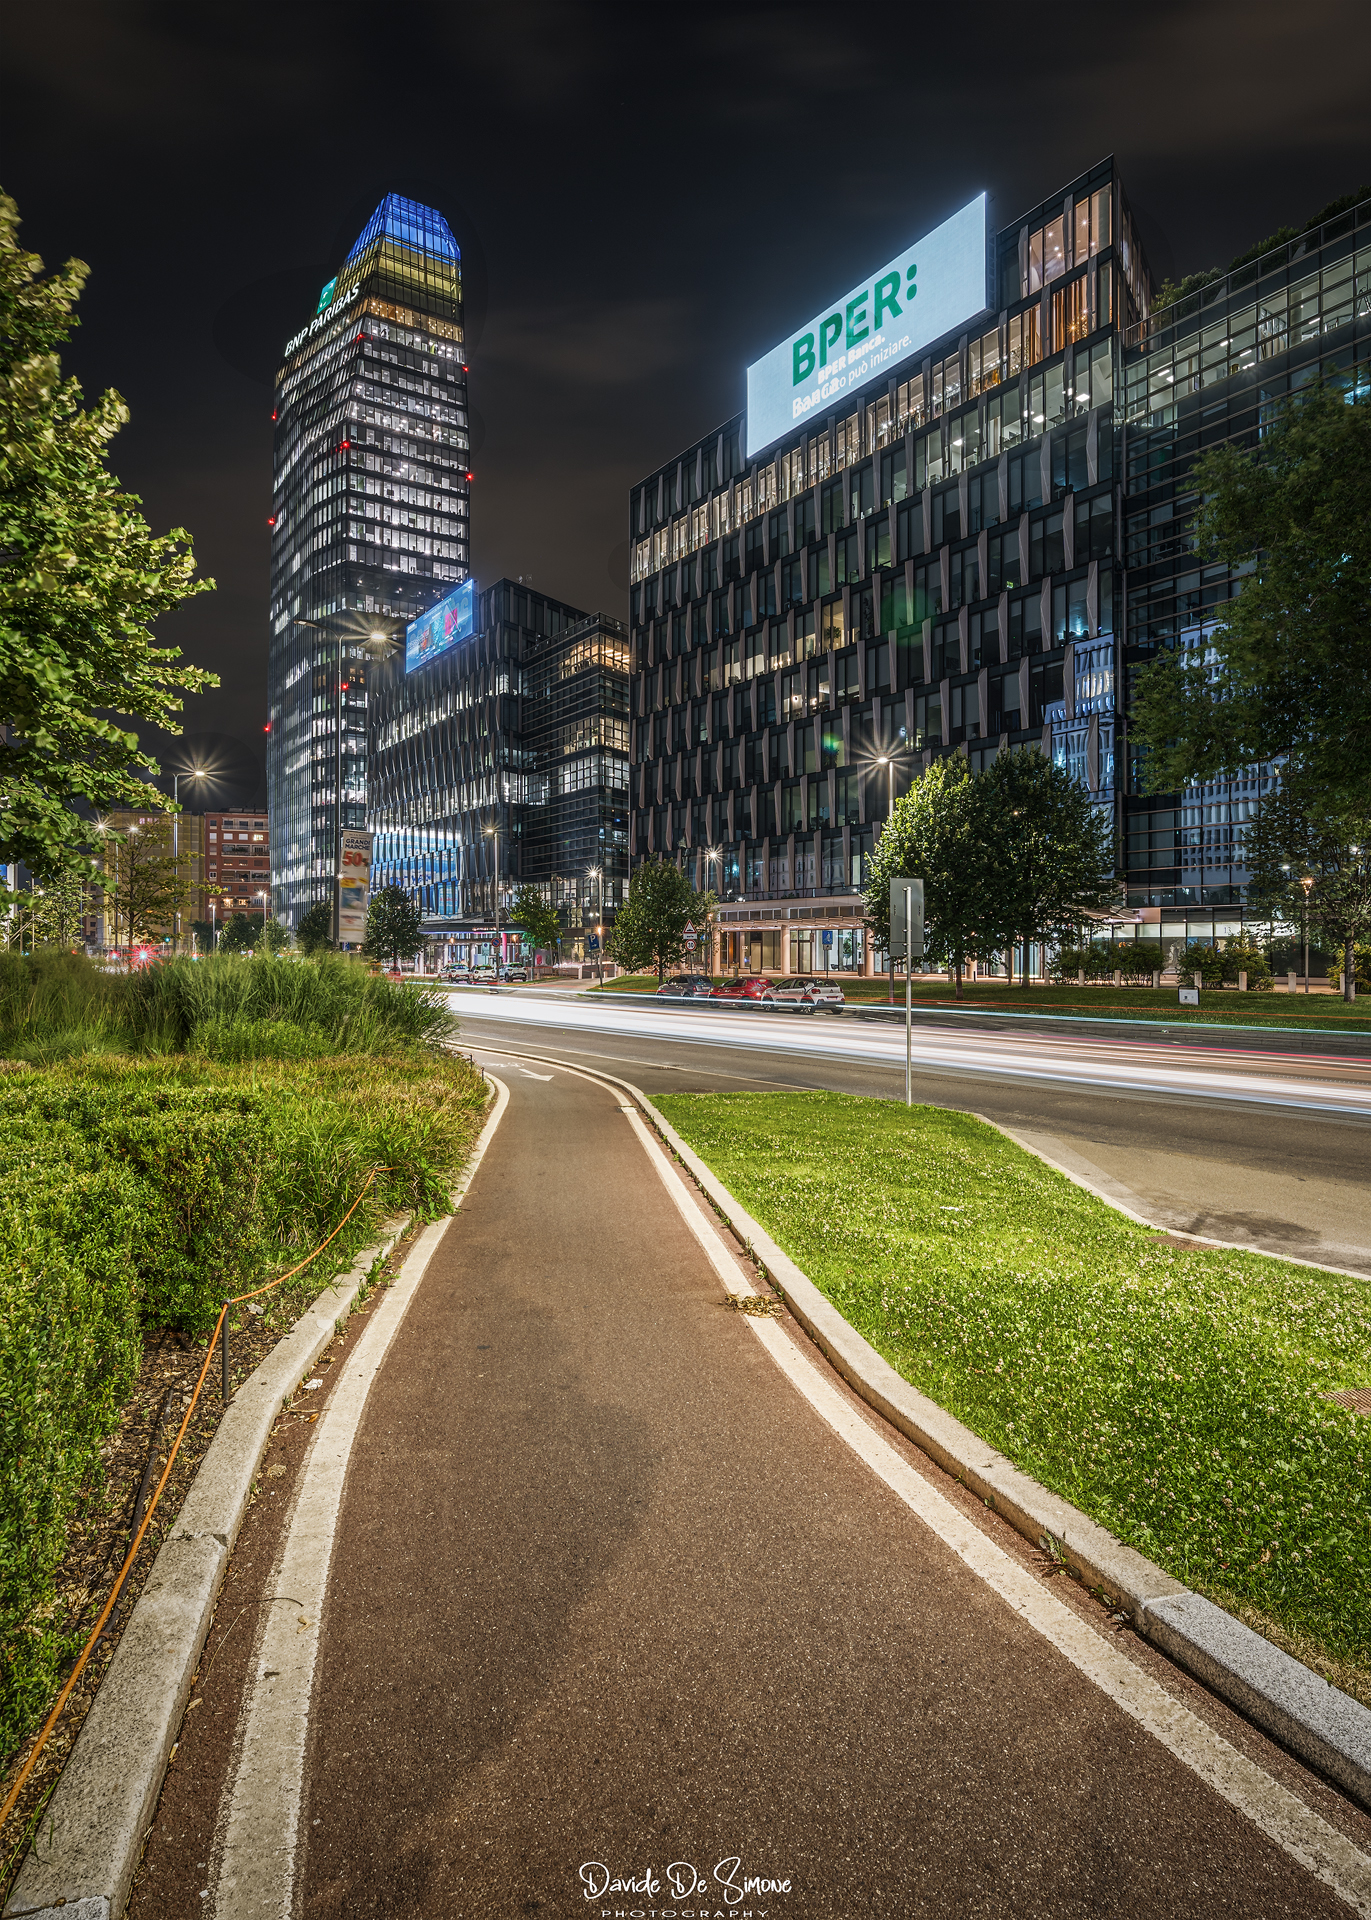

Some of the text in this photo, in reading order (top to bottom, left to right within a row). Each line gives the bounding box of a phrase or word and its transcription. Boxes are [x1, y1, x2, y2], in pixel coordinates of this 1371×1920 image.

[284, 281, 360, 357] BNP PARIBAS
[817, 334, 886, 385] BPER Banca.
[848, 335, 912, 386] può iniziare.
[345, 838, 371, 846] GRANDI
